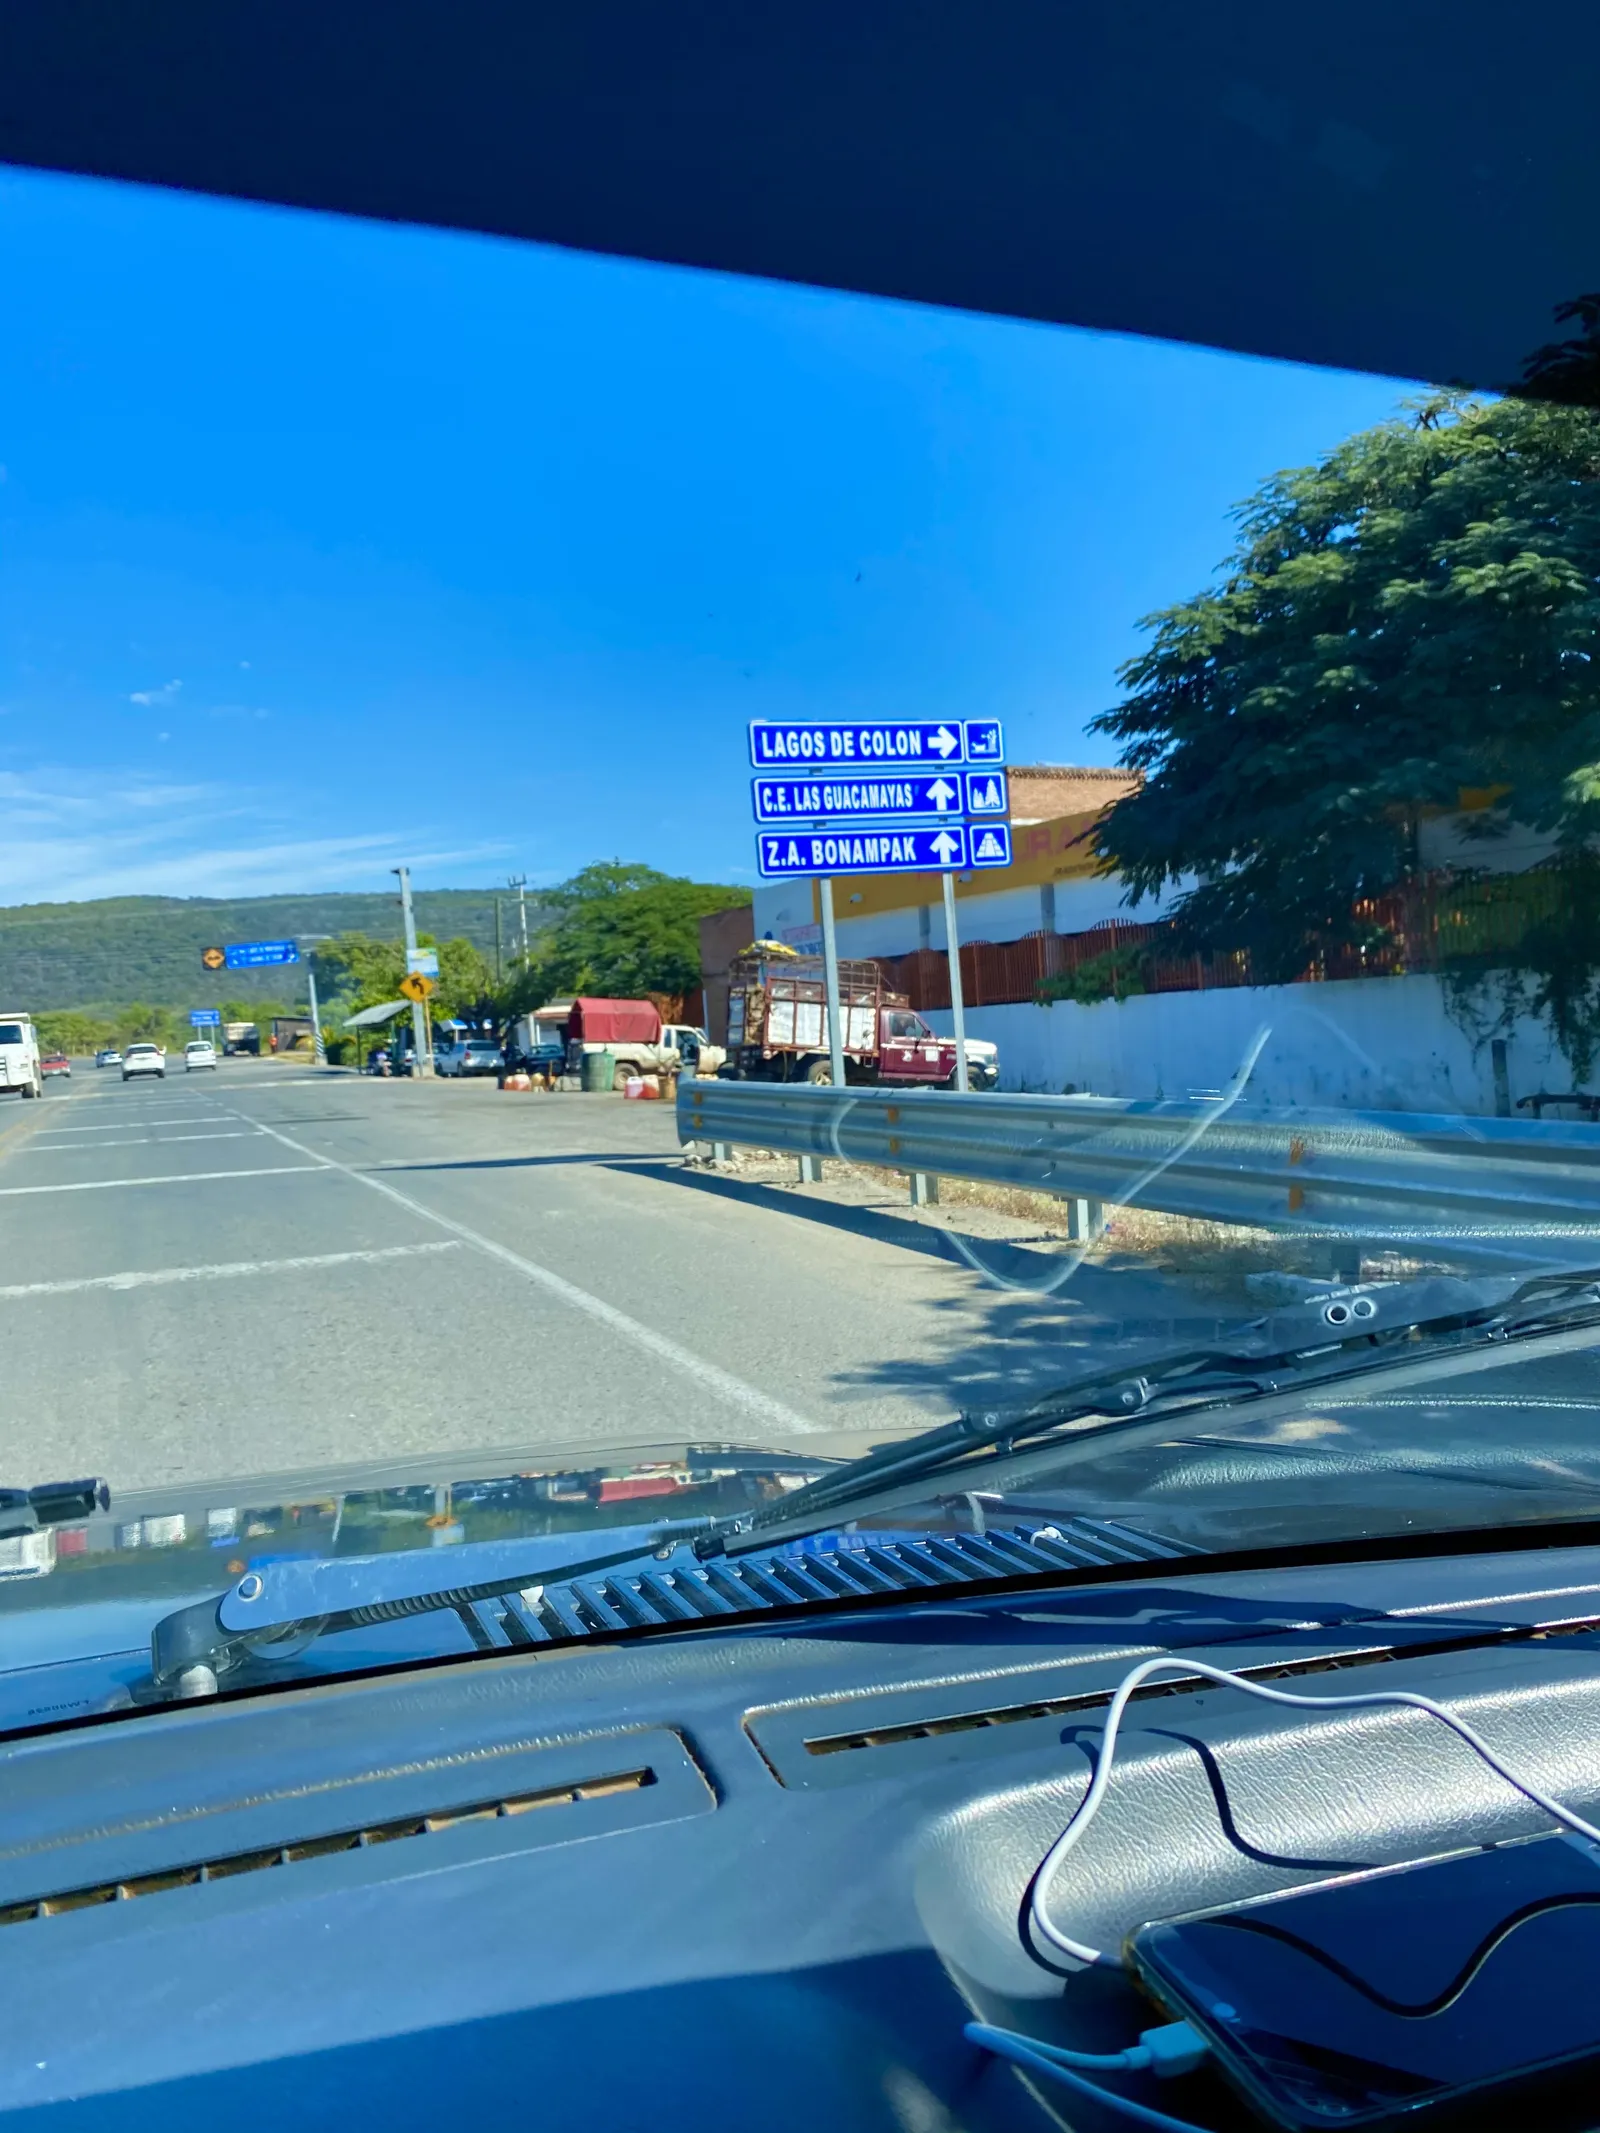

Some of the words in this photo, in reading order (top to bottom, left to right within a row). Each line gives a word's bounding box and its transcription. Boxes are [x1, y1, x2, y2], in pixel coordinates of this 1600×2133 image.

[761, 731, 826, 758] LAGOS
[830, 731, 855, 757] DE
[859, 730, 921, 757] COLON
[763, 787, 791, 812] C.E.
[794, 786, 821, 811] LAS
[823, 784, 913, 811] GUACAMAYAS
[767, 841, 806, 867] Z.A.
[813, 836, 917, 865] BONAMPAK
